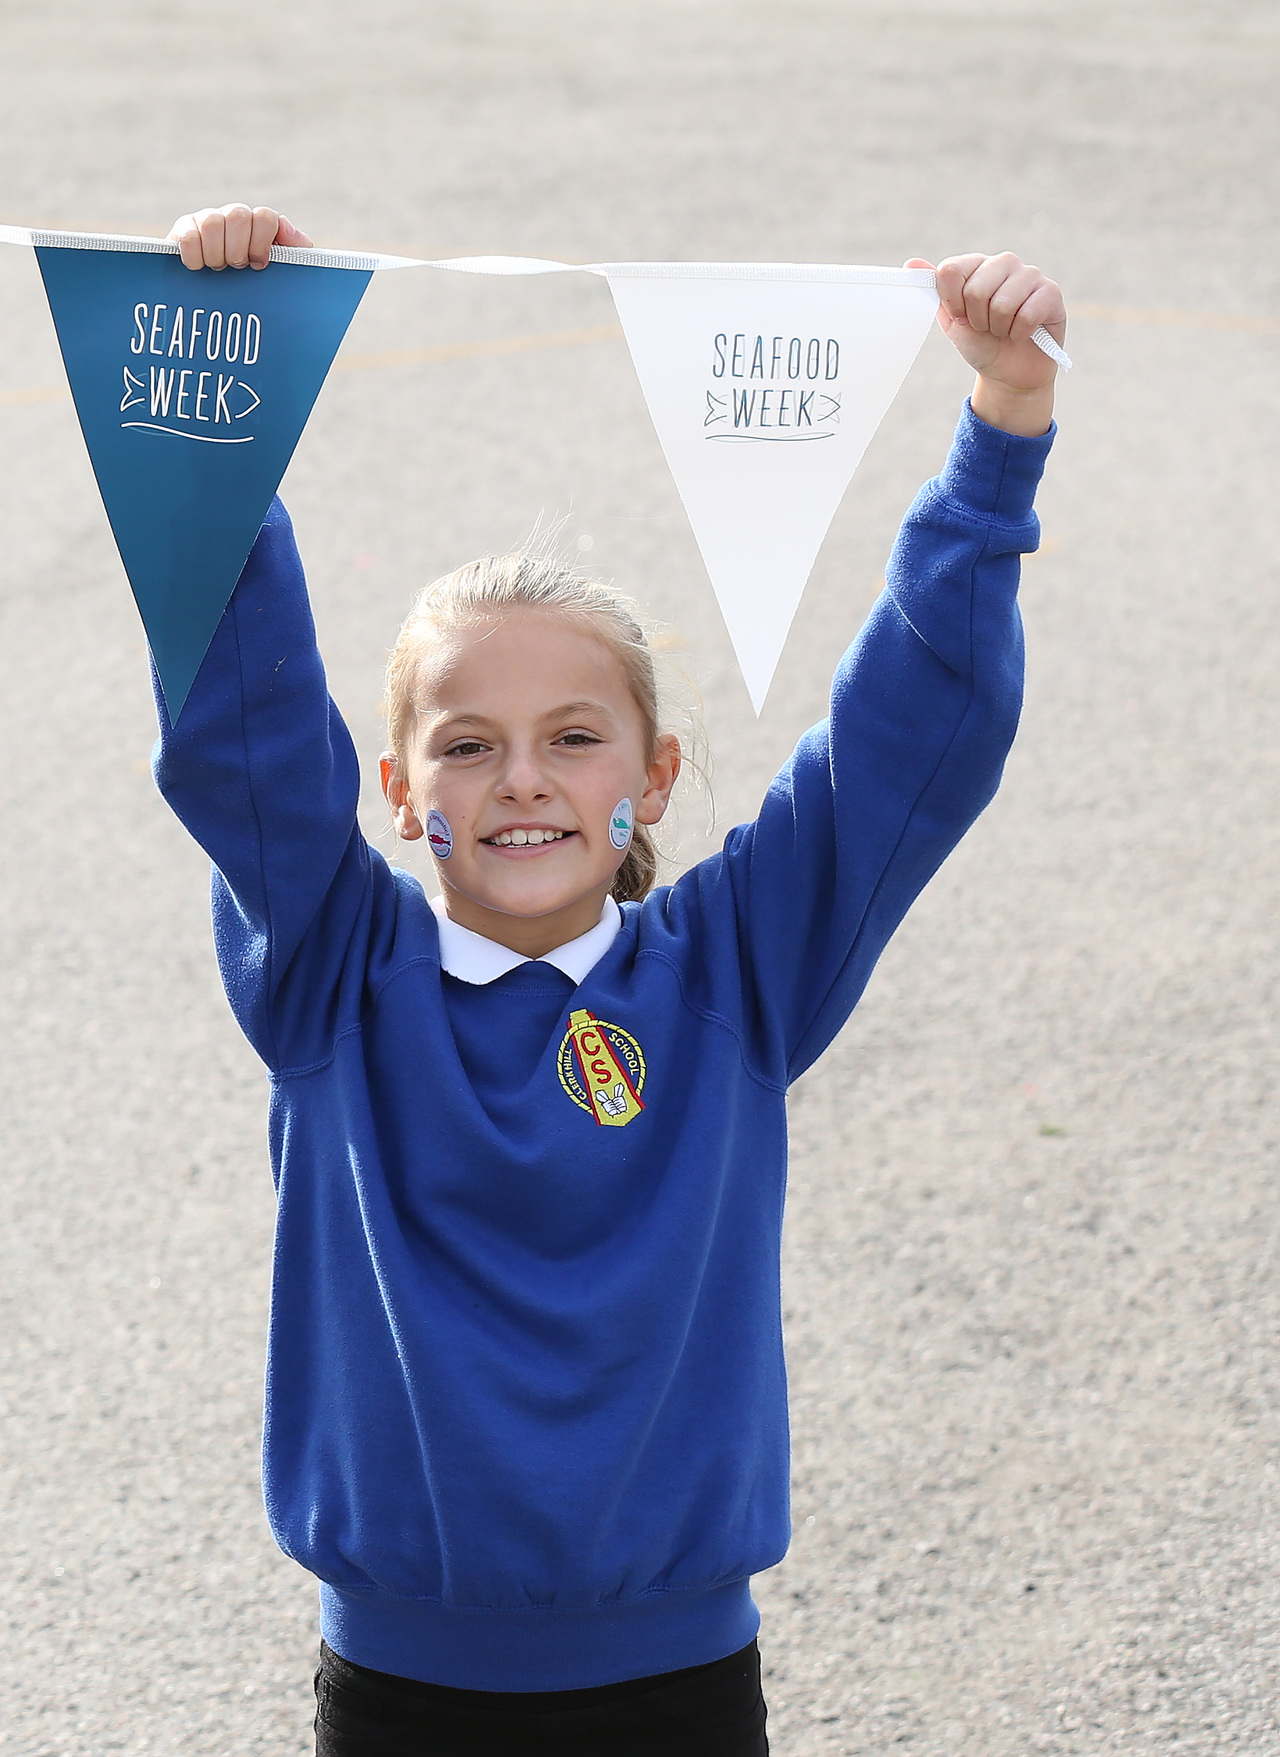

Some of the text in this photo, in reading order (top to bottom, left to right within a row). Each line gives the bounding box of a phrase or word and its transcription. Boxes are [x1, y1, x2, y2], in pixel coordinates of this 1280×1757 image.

[130, 302, 262, 365] SEAFOOD
[712, 333, 839, 380] SEAFOOD
[149, 365, 235, 425] WEEK
[732, 388, 815, 428] WEEK
[562, 1048, 588, 1101] CLERKHILL
[608, 1032, 640, 1076] SCHOOL
